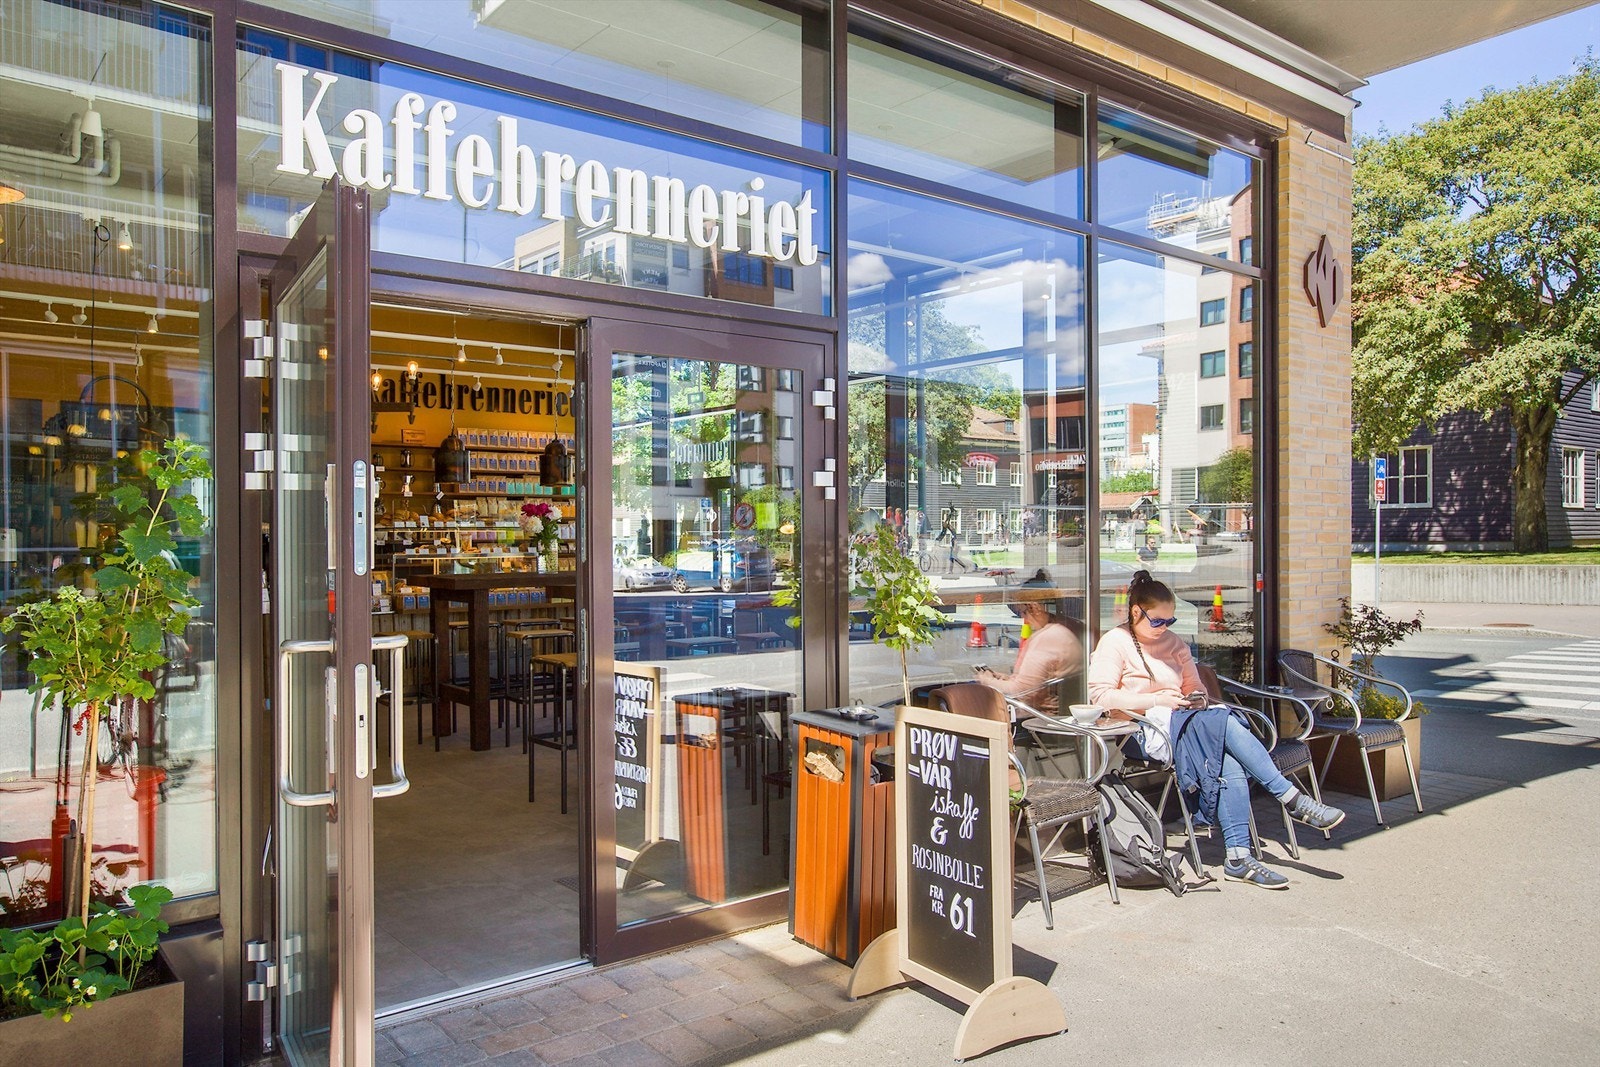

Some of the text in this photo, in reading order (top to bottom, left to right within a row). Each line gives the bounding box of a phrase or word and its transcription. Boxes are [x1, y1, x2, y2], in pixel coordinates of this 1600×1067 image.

[276, 63, 818, 266] Kaffebrenneriet
[910, 727, 957, 761] PRØV
[919, 756, 952, 791] VÅR
[930, 791, 980, 839] iskaffe
[930, 817, 948, 845] &
[912, 844, 984, 889] ROSINBOLLE
[929, 885, 944, 901] FRA
[950, 892, 977, 937] 61
